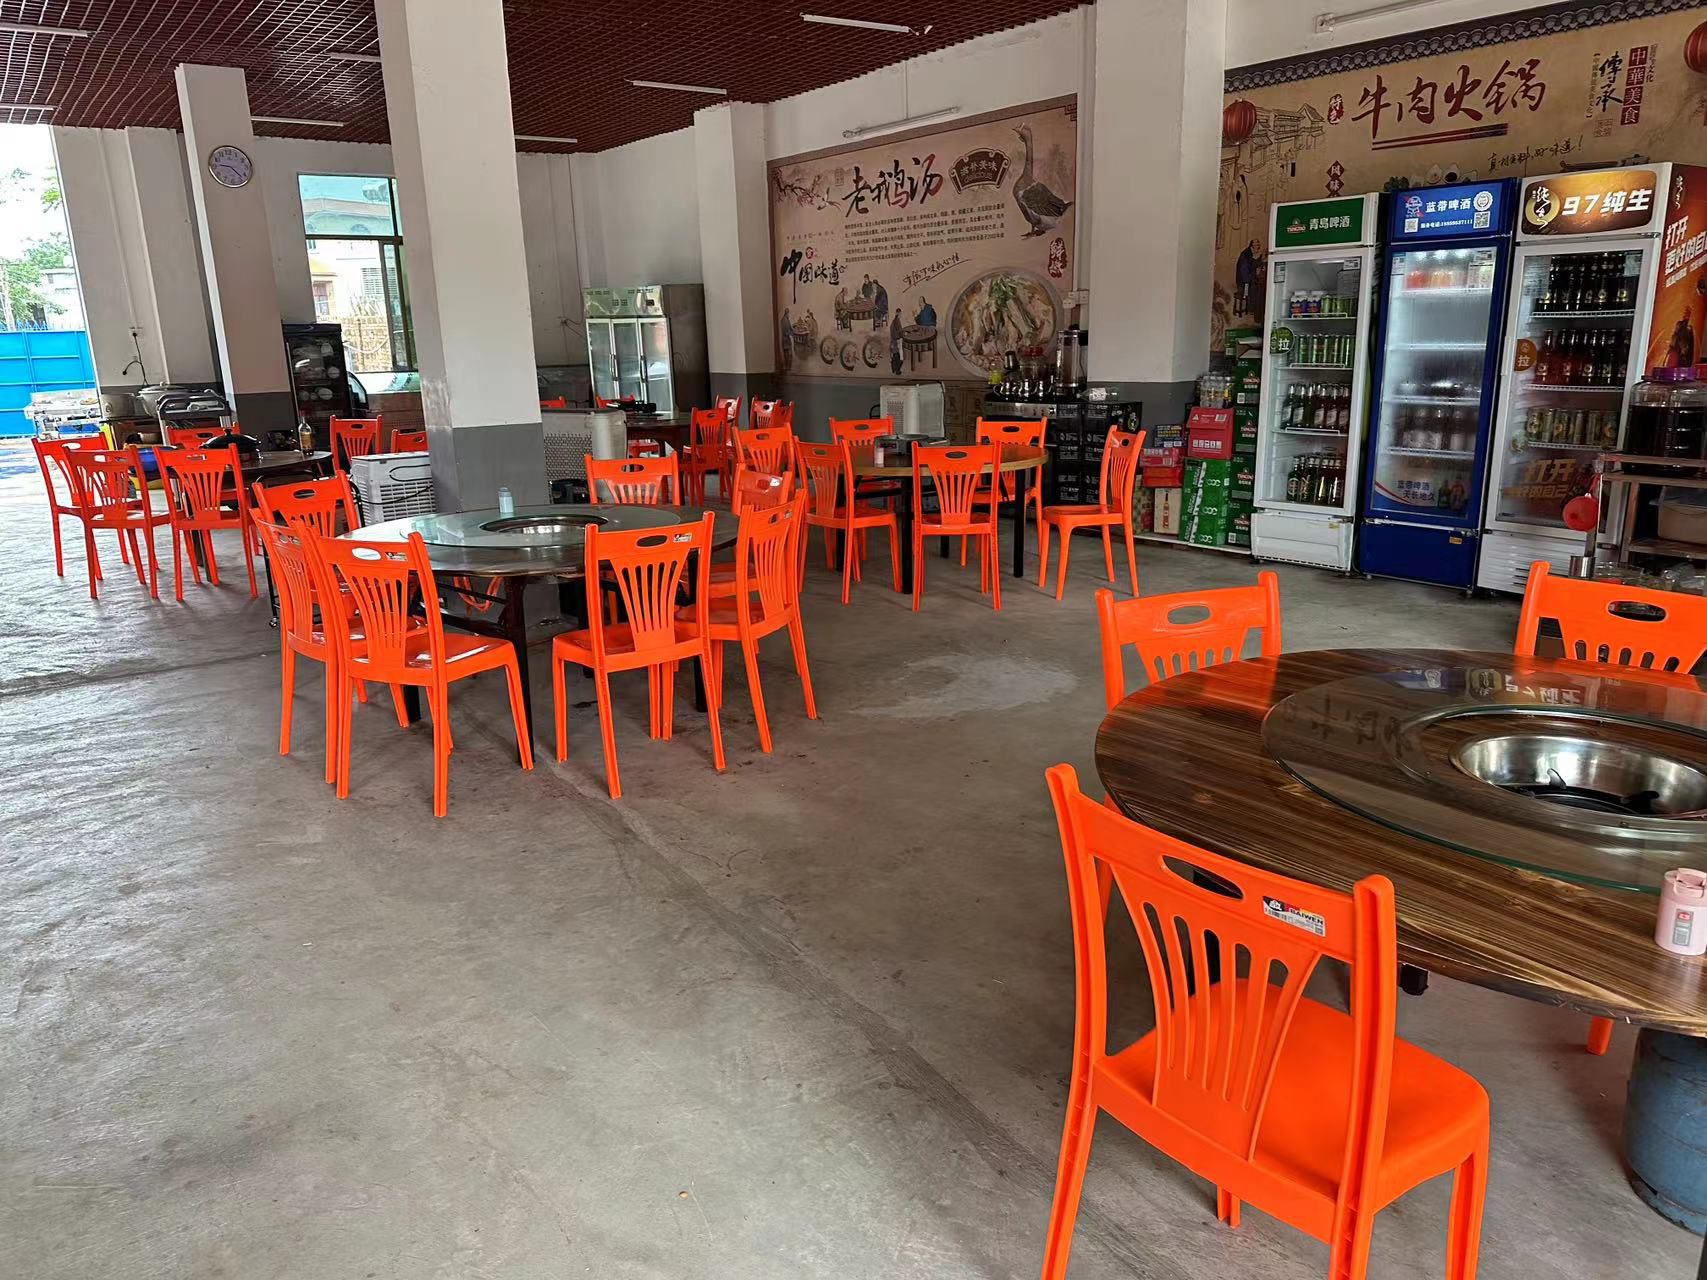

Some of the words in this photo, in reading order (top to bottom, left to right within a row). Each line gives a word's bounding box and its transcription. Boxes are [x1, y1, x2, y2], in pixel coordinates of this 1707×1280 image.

[1351, 58, 1546, 139] 牛肉火锅
[1596, 51, 1624, 112] 傳承
[1624, 48, 1647, 124] 中華美食
[842, 153, 944, 217] 老鹅汤
[1561, 188, 1653, 217] 97纯生
[1425, 197, 1472, 213] 蓝带啤酒
[1309, 215, 1351, 231] 青岛啤酒
[1665, 215, 1689, 250] 打开
[1664, 231, 1707, 276] 更好的自
[780, 249, 840, 305] 中国味道
[1278, 337, 1290, 351] 拉
[1518, 354, 1531, 367] 拉
[1524, 458, 1577, 482] 打开
